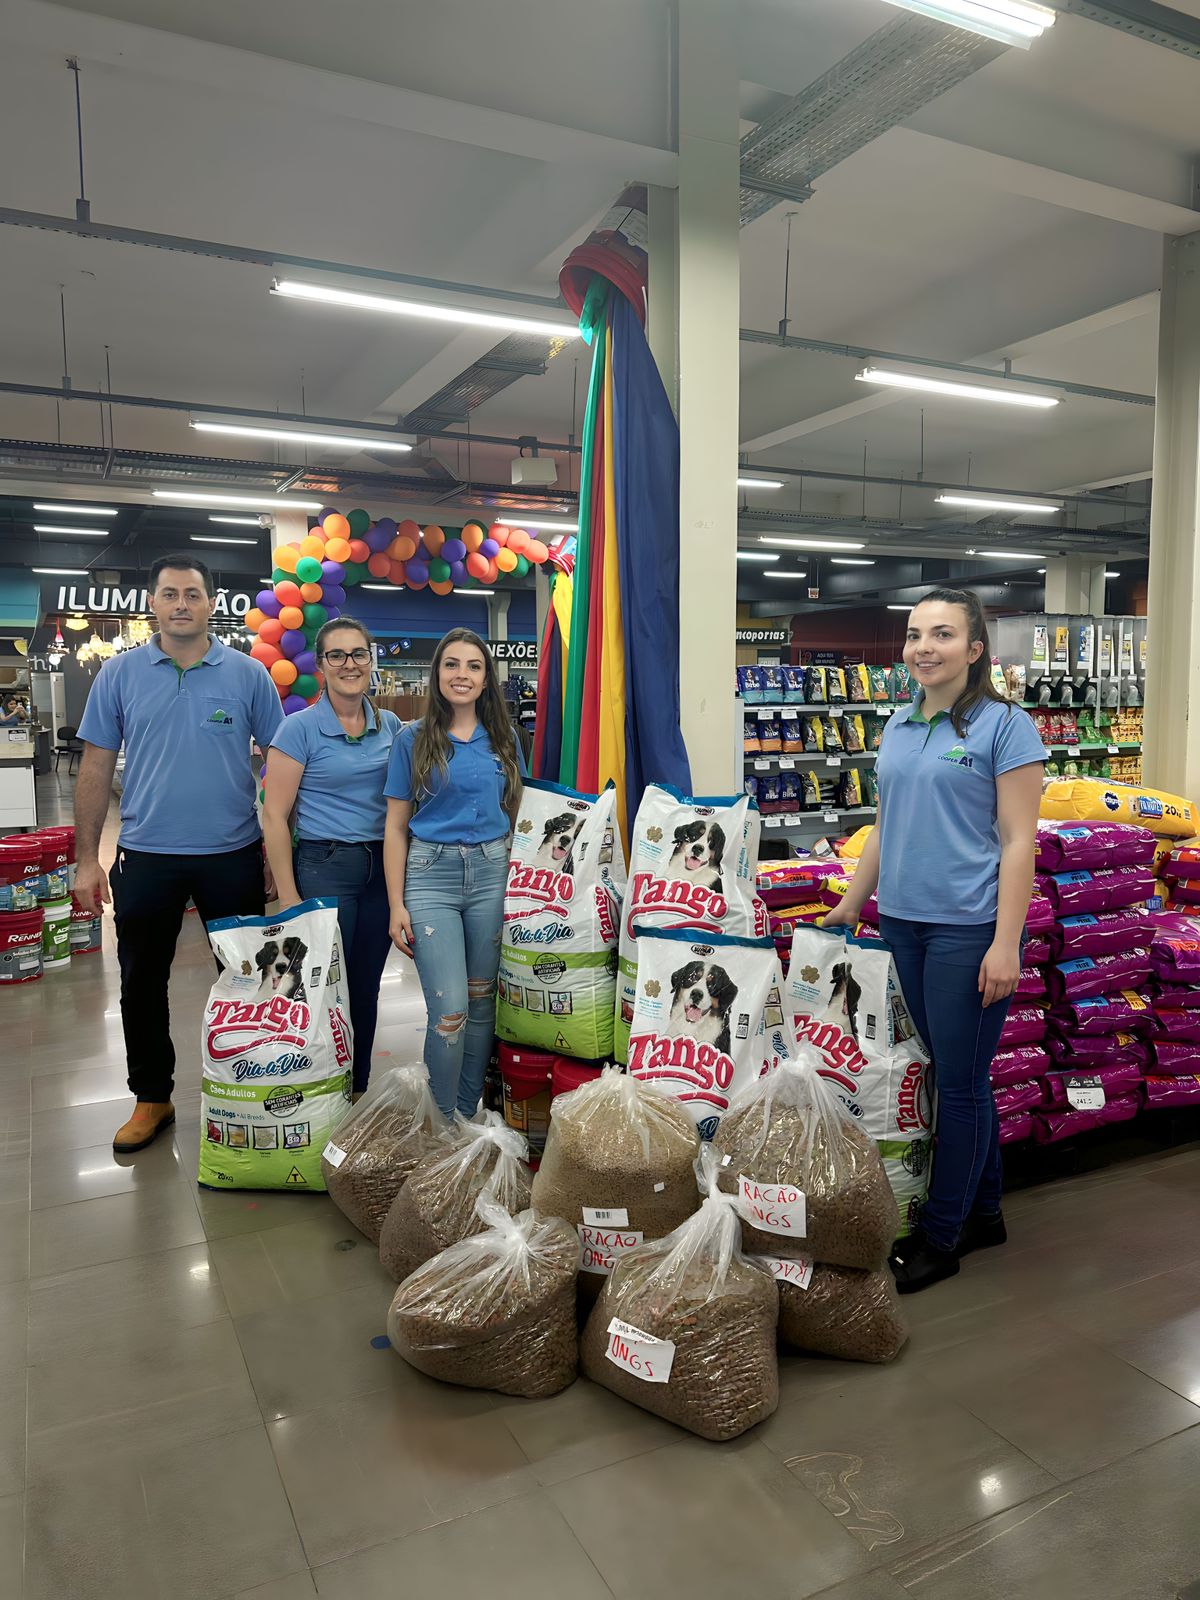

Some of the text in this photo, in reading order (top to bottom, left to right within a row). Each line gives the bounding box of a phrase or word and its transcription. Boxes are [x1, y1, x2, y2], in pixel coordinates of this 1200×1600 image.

[58, 585, 250, 616] ILUMIÃO
[959, 755, 974, 768] A1
[510, 922, 574, 945] Dia-a-Dia
[232, 1052, 312, 1080] Dia-a-Dia
[629, 1033, 735, 1090] Tango
[209, 1084, 257, 1098] Cães Adultos
[896, 1062, 923, 1132] Tango
[208, 1106, 221, 1116] Adult
[221, 1108, 236, 1119] Dogs
[743, 1182, 797, 1210] RAÇÃO
[582, 1228, 637, 1252] RAÇÃO
[611, 1334, 655, 1377] ONGS
